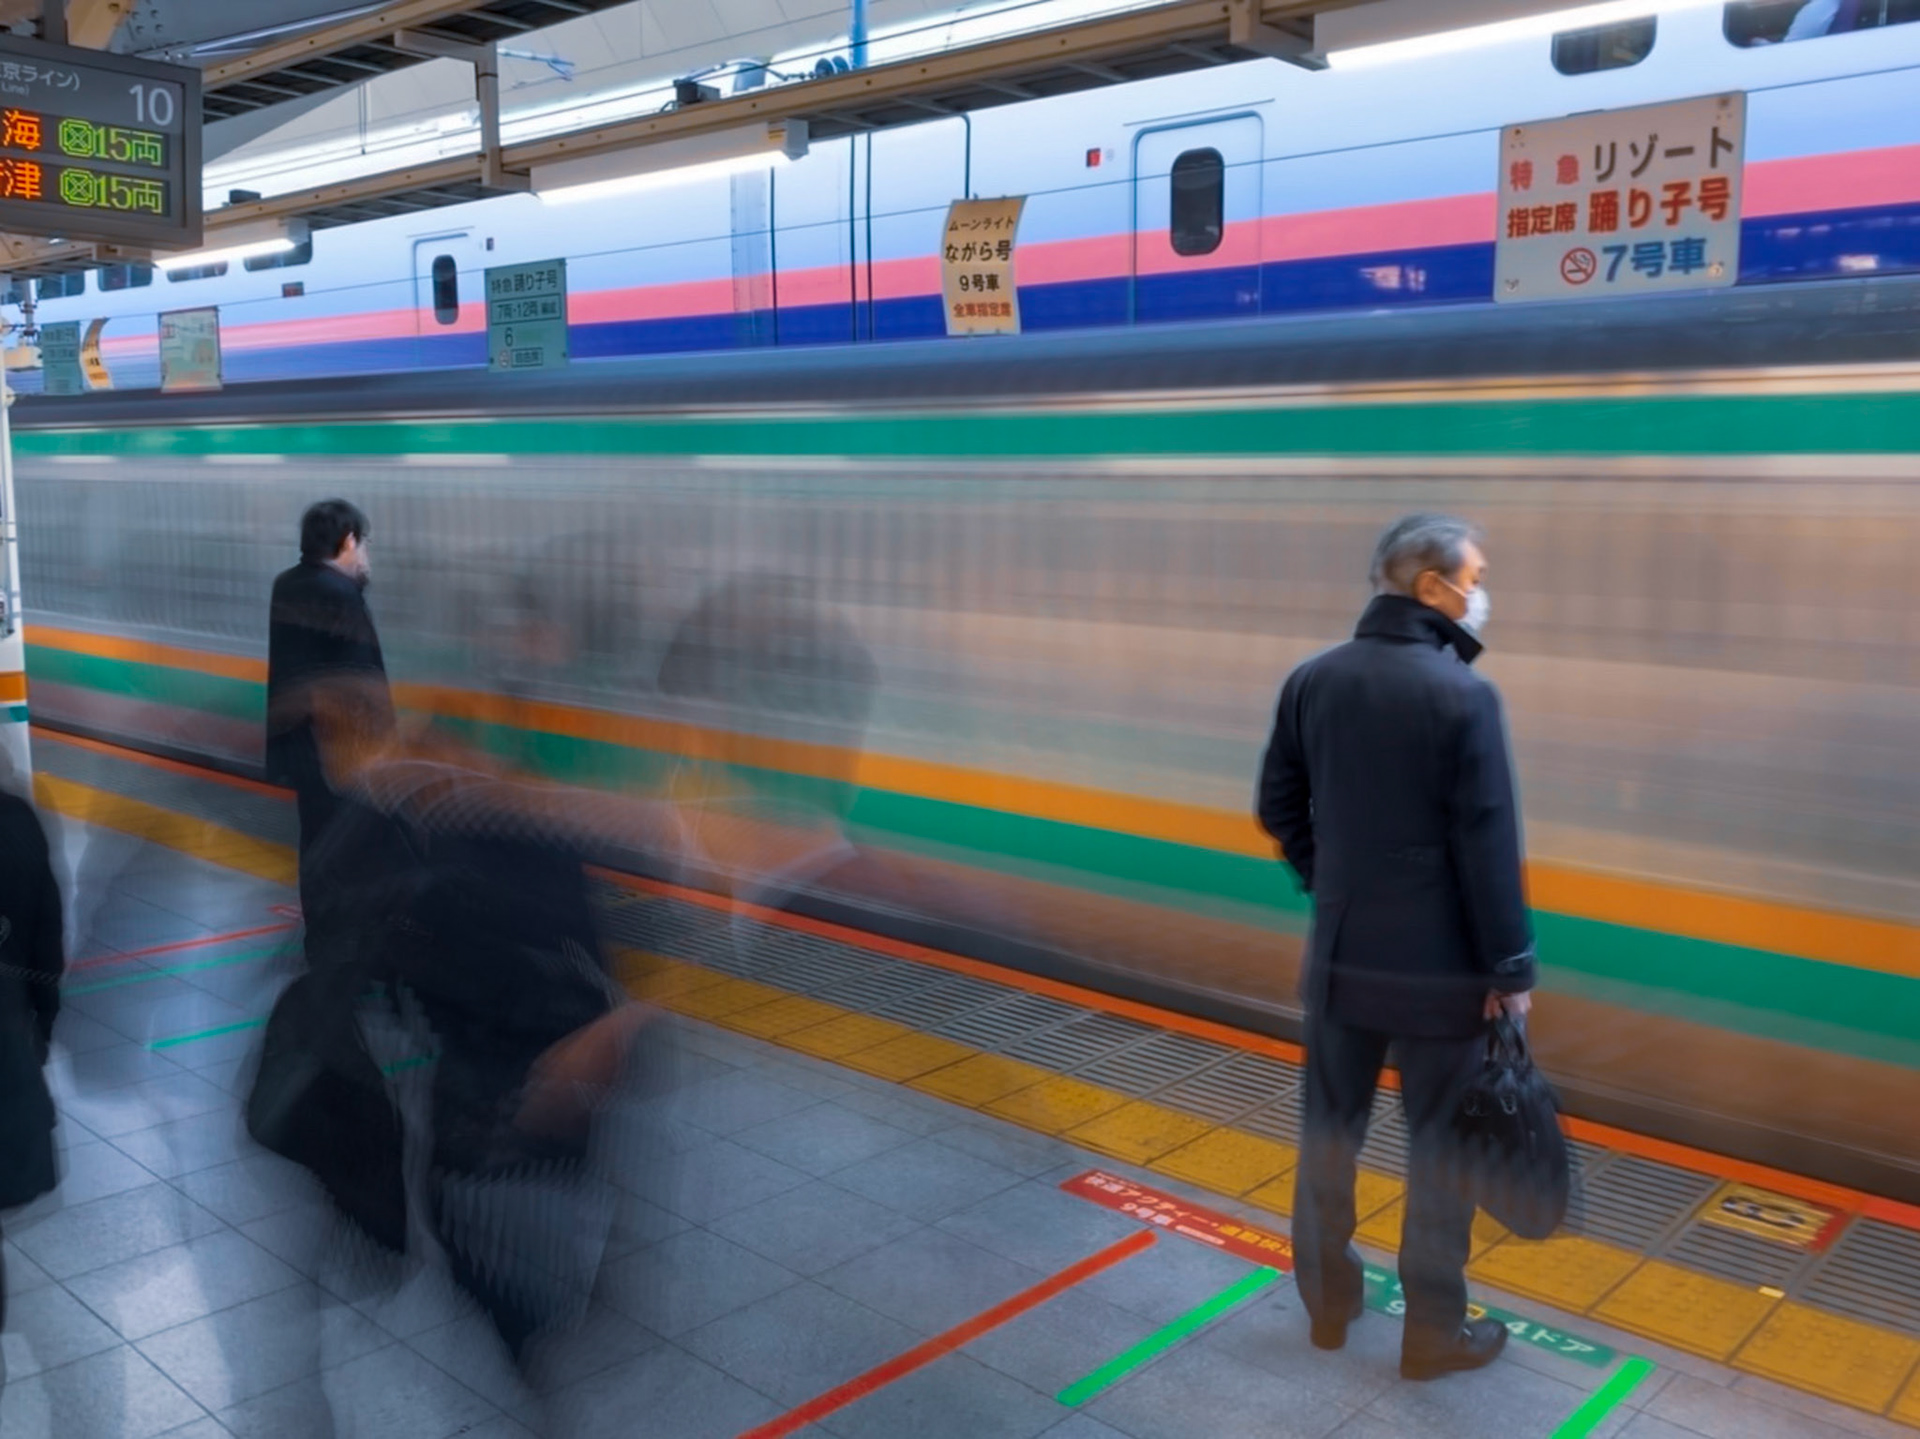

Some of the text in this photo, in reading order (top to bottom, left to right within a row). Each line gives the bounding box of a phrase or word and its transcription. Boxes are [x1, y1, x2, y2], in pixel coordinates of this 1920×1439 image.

[0, 61, 81, 91] 京ライン)
[128, 83, 175, 127] 10
[3, 109, 165, 168] 海 15両
[1594, 126, 1734, 183] リゾート
[0, 159, 165, 215] 津 15両
[1506, 177, 1731, 239] 指定席 踊り子号
[948, 215, 1014, 232] ムーンライト
[945, 239, 1013, 264] ながら号
[1602, 237, 1707, 283] 7号車
[959, 273, 1000, 293] 9号車
[505, 327, 513, 347] 6
